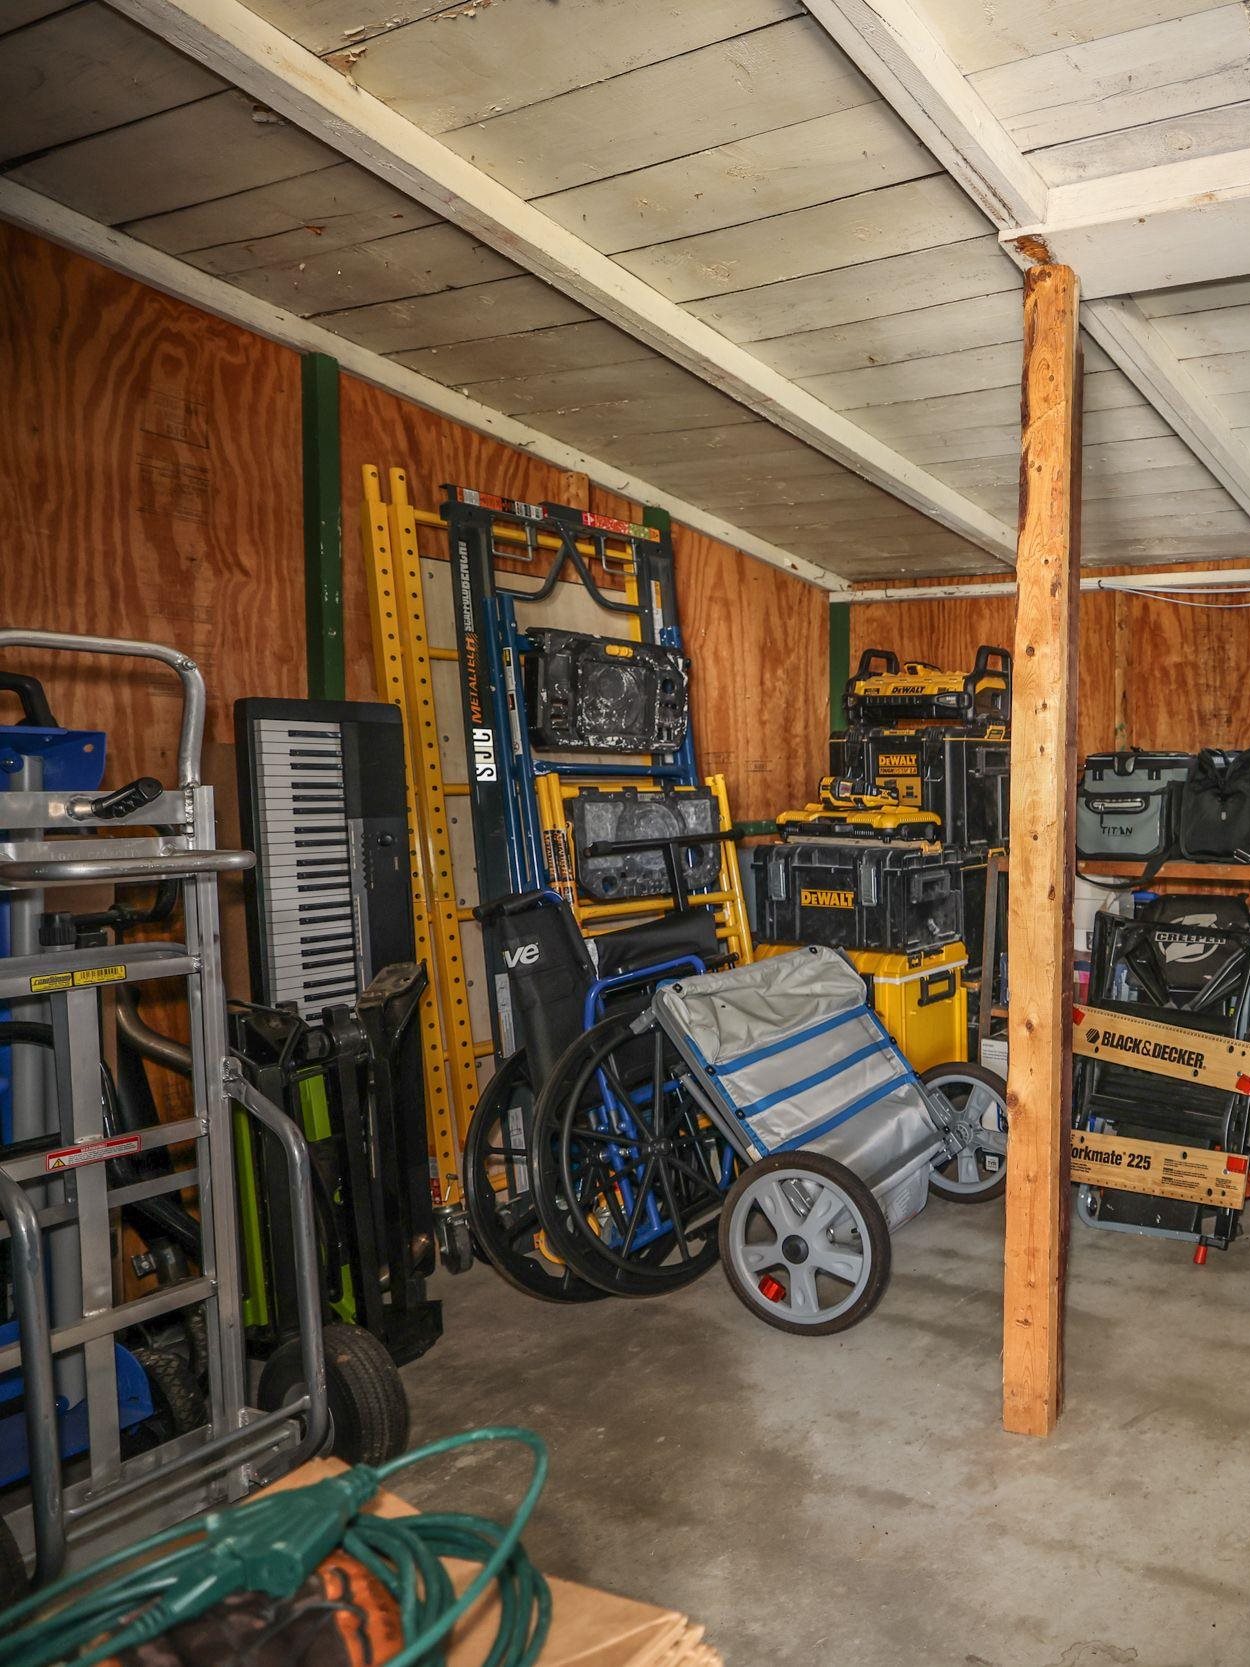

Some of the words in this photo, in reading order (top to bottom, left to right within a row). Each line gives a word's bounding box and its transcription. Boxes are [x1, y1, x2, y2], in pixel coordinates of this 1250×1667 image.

[892, 686, 926, 694] DEWALT
[473, 729, 495, 780] SJC
[879, 755, 917, 766] DEWALT
[1101, 826, 1133, 835] TITAN
[801, 890, 855, 908] DEWALT
[503, 943, 540, 968] ve
[1101, 1030, 1205, 1069] BLACK&DECKER
[1071, 1144, 1123, 1166] orkmate
[1127, 1153, 1152, 1171] 225
